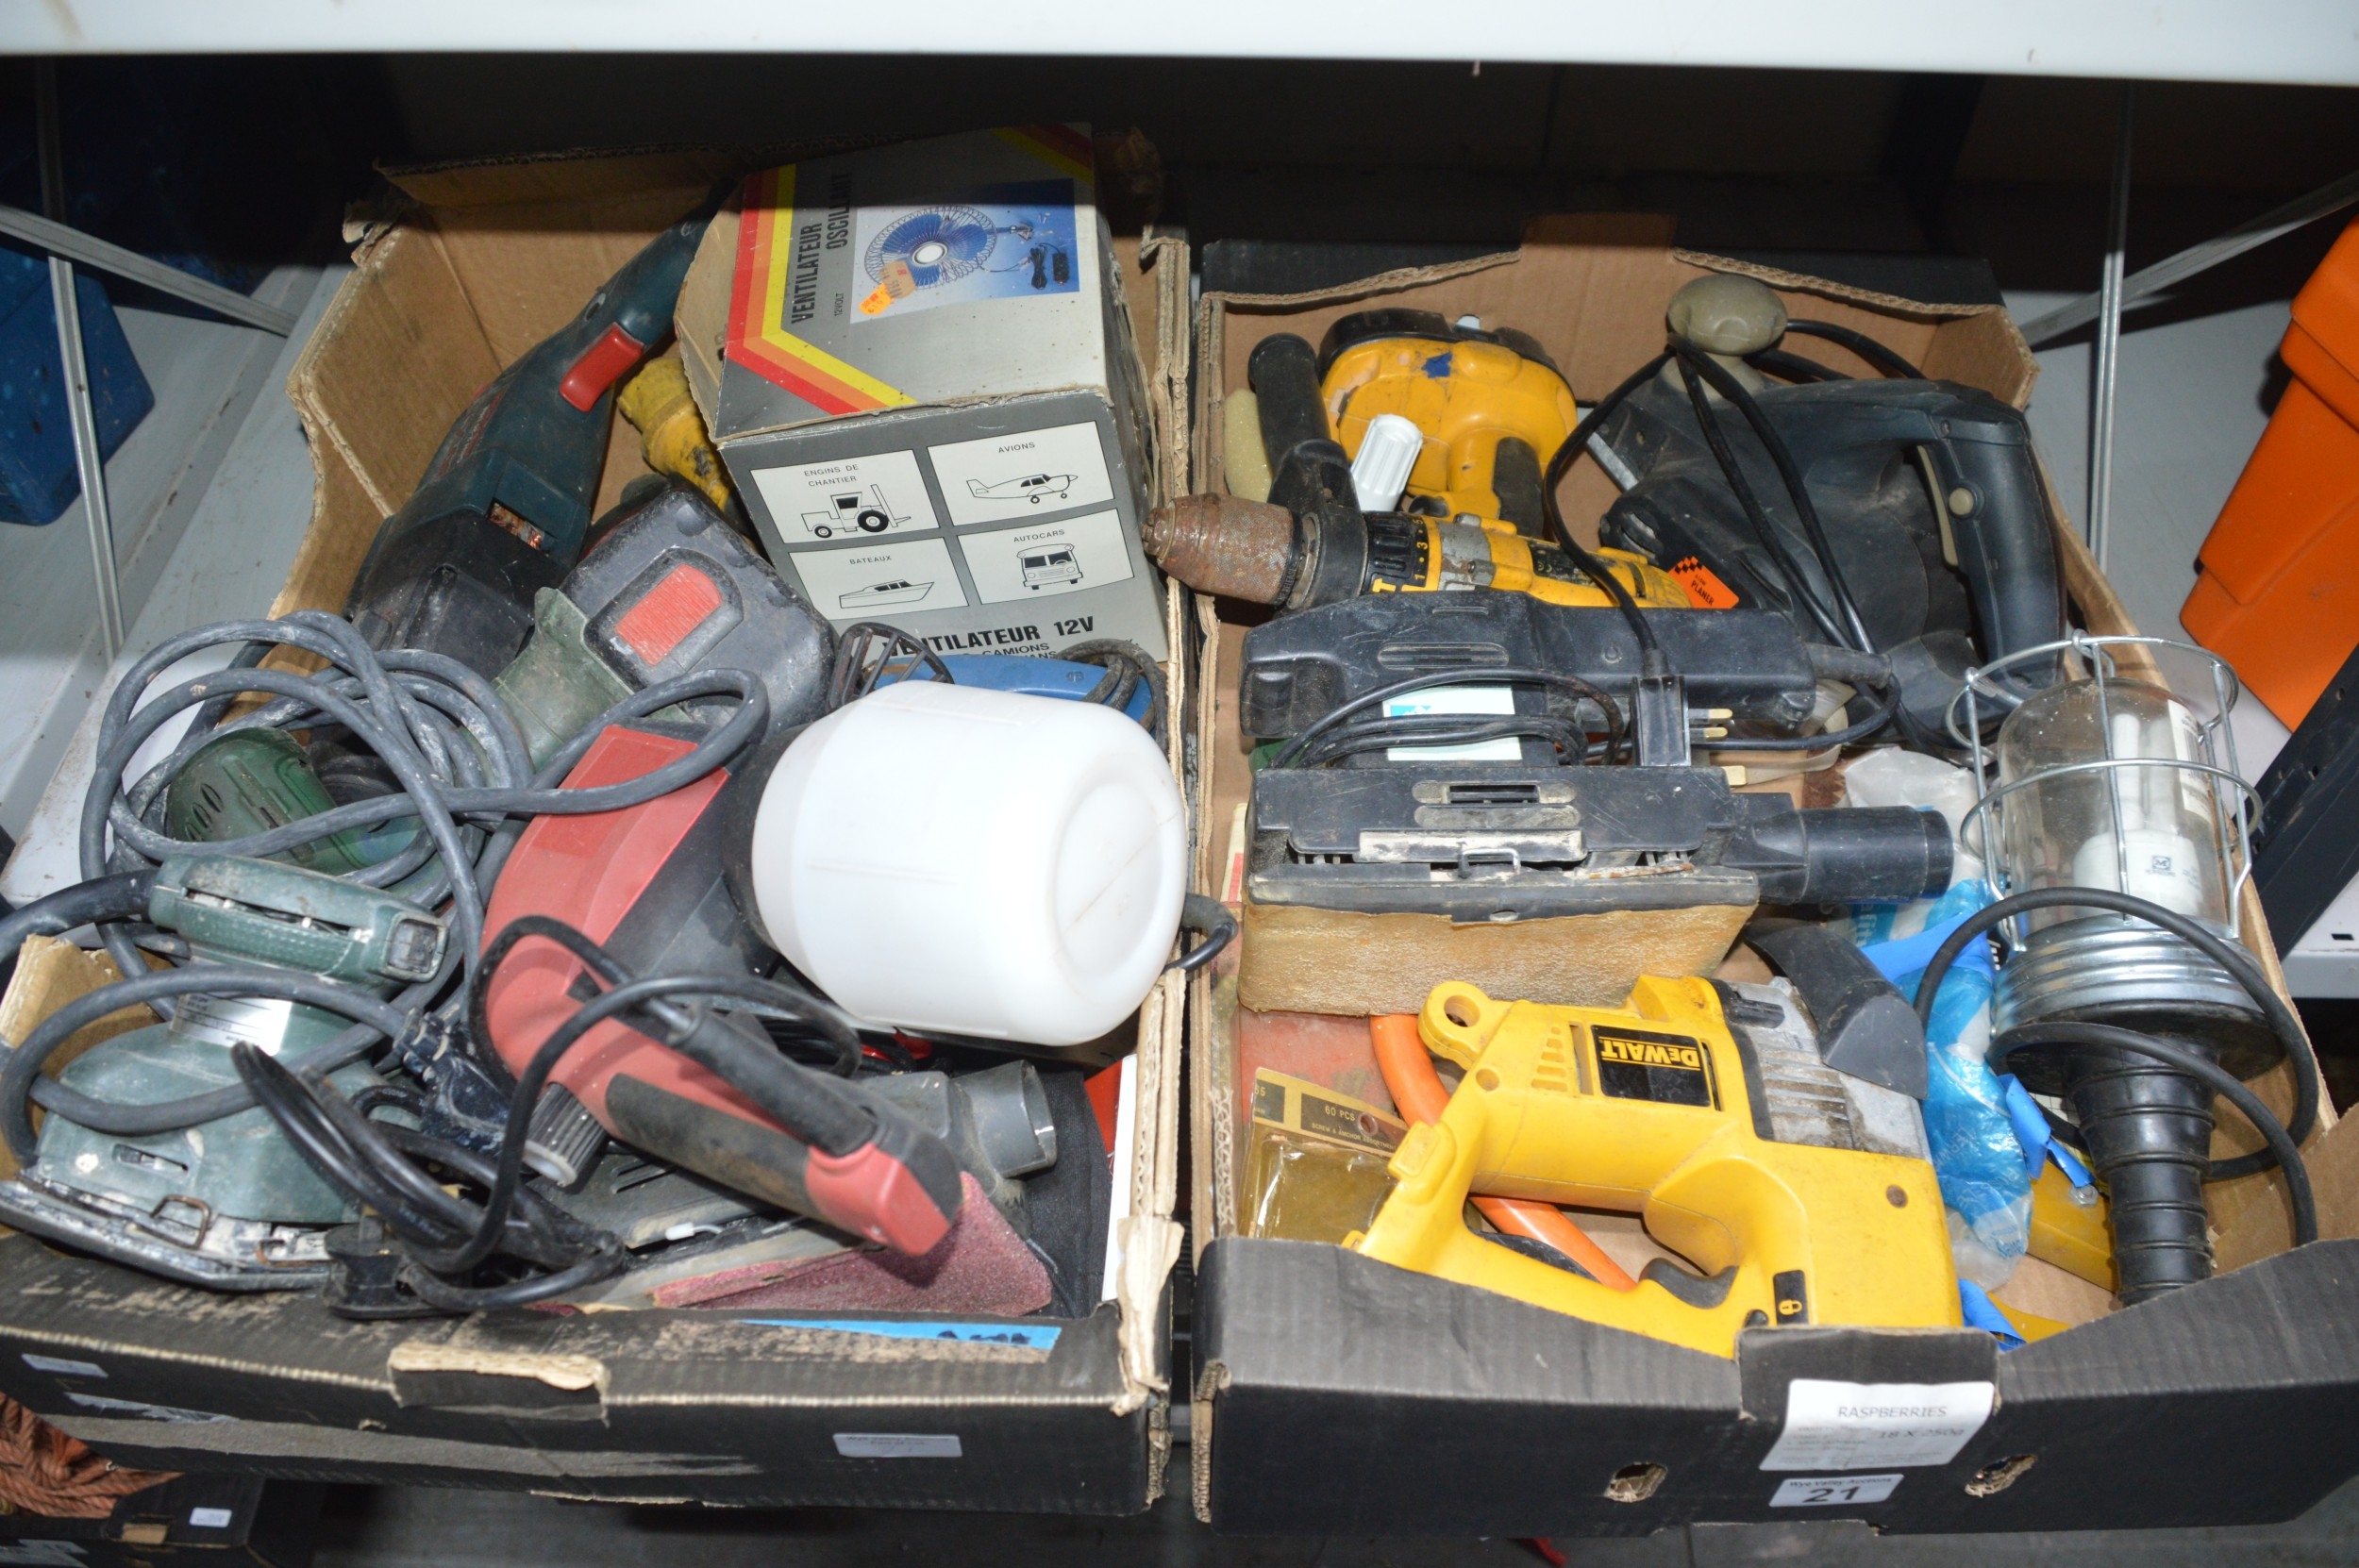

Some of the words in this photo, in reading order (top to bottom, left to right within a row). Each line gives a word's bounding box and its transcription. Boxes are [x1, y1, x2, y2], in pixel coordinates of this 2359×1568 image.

[826, 172, 852, 250] OSCILLANT
[791, 222, 823, 324] VENTILATEUR
[834, 292, 845, 316] 12VOLT
[998, 442, 1035, 453] AVIONS
[804, 466, 841, 476] ENGINS
[845, 463, 860, 472] DE
[808, 475, 857, 487] CHANTIER
[1013, 529, 1065, 542] AUTOCARS
[1416, 542, 1429, 550] 3
[849, 555, 892, 565] BATEAUX
[1690, 579, 1715, 606] PLANER
[1053, 616, 1094, 637] 12V
[1325, 1105, 1336, 1117] 60
[1339, 1109, 1355, 1122] PCS
[1311, 1122, 1331, 1133] SCREW
[1838, 1405, 1949, 1419] RASPBERRIES
[1879, 1430, 1899, 1439] 18
[1802, 1486, 1861, 1503] 21
